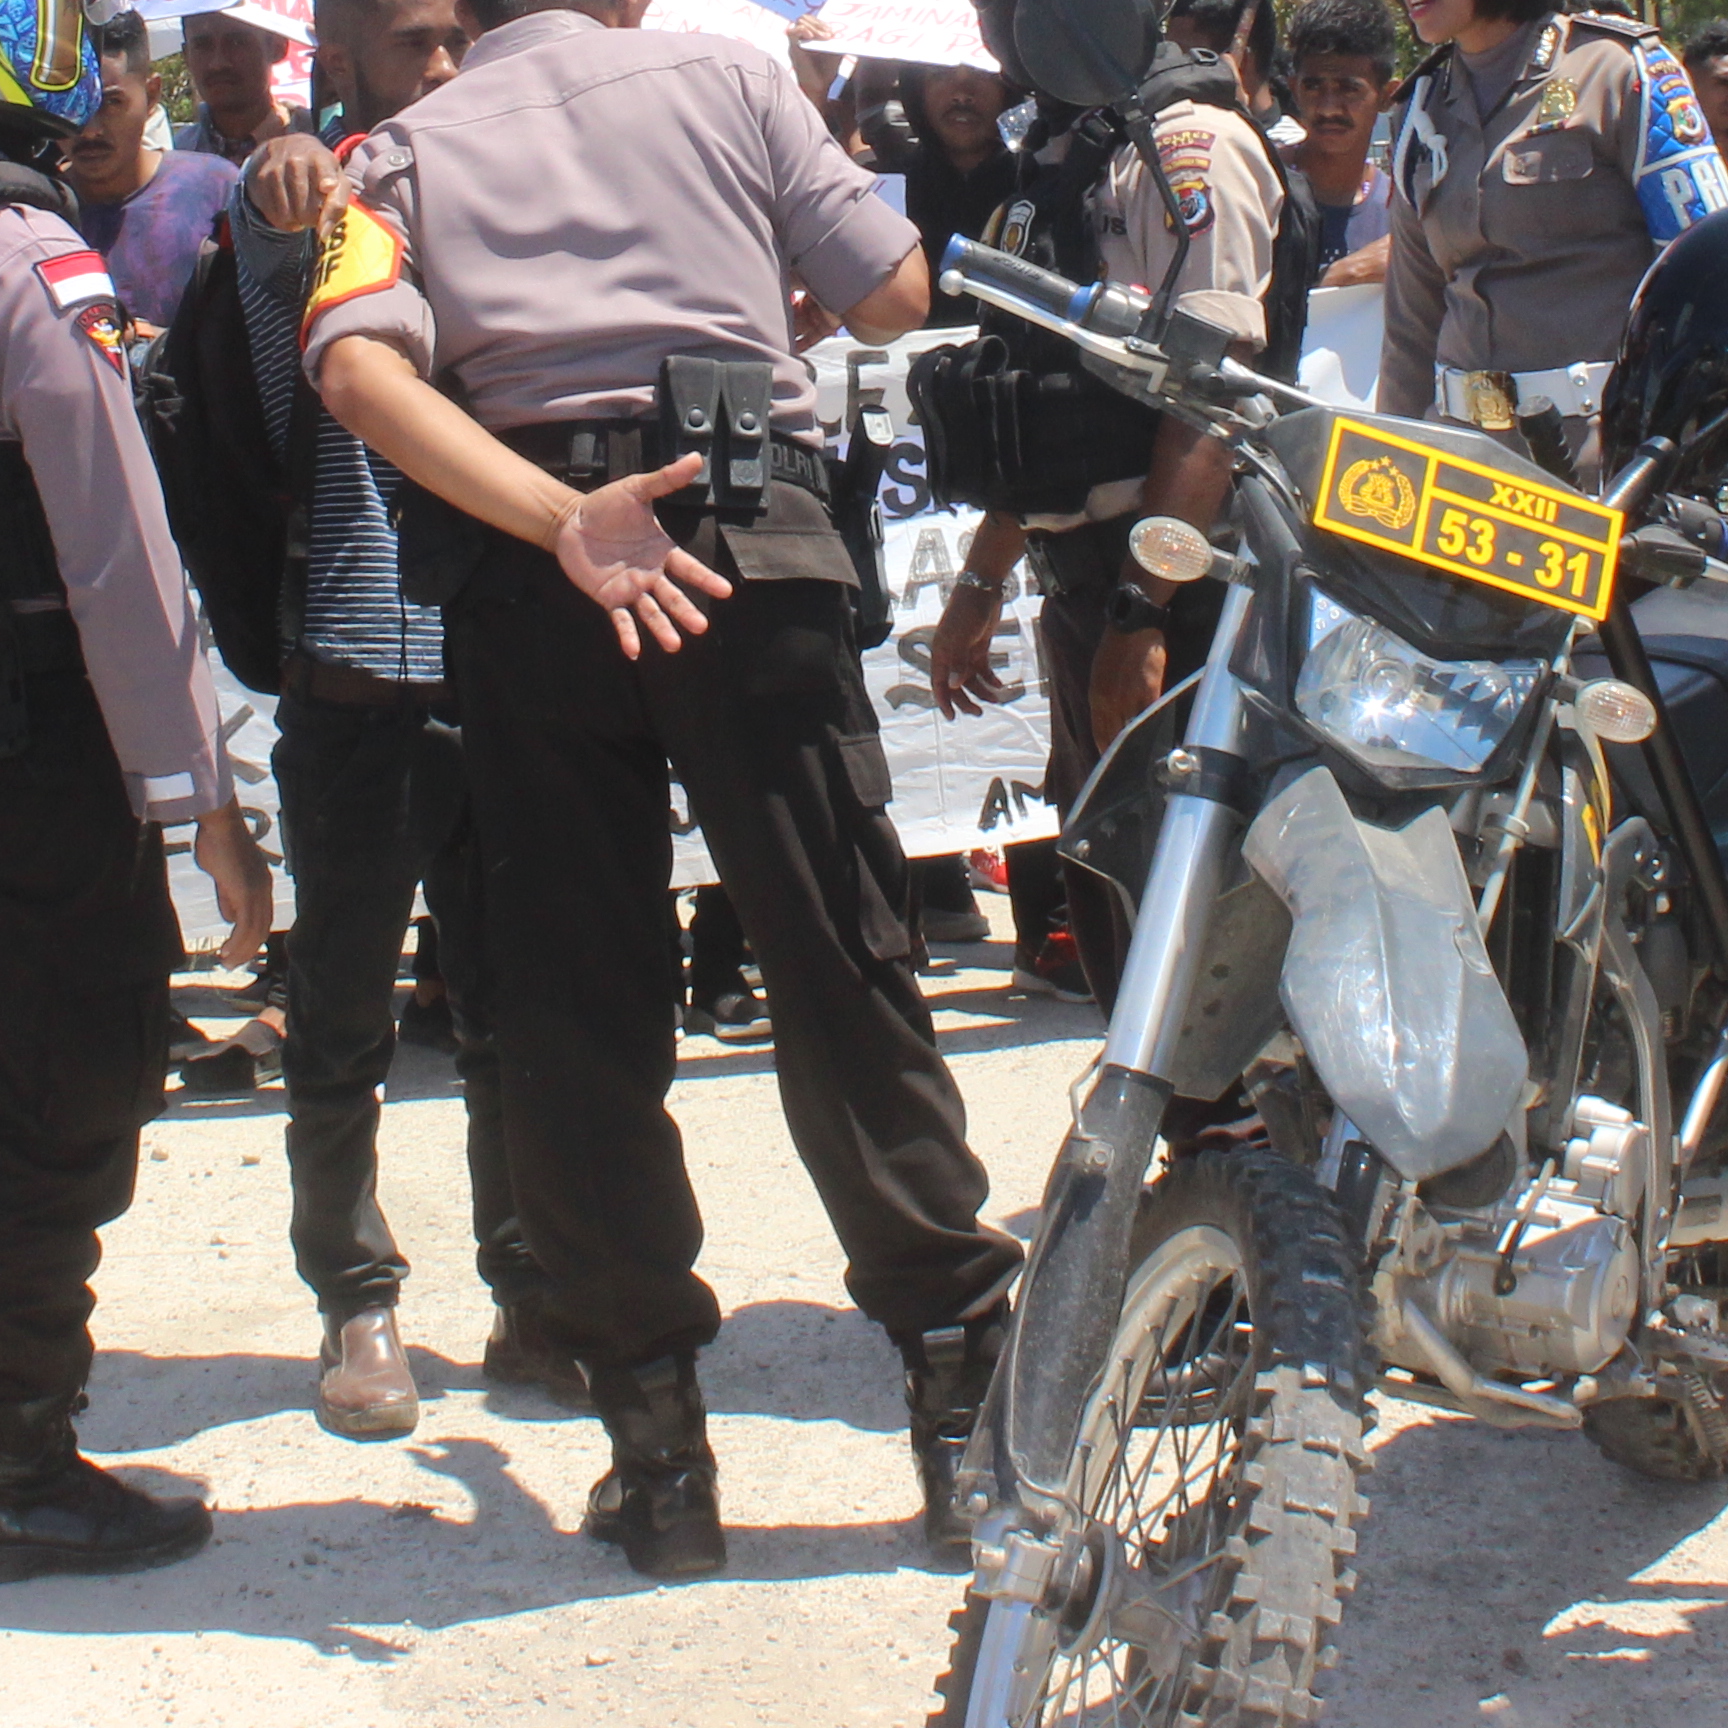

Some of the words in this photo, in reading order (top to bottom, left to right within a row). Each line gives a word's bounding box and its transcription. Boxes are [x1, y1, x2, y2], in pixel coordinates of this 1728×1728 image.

[831, 2, 979, 29] JAMINA
[828, 22, 925, 48] BAGI
[1488, 481, 1559, 523] XXII
[1436, 508, 1496, 566] 53
[1504, 550, 1527, 568] -
[1533, 539, 1591, 599] 31
